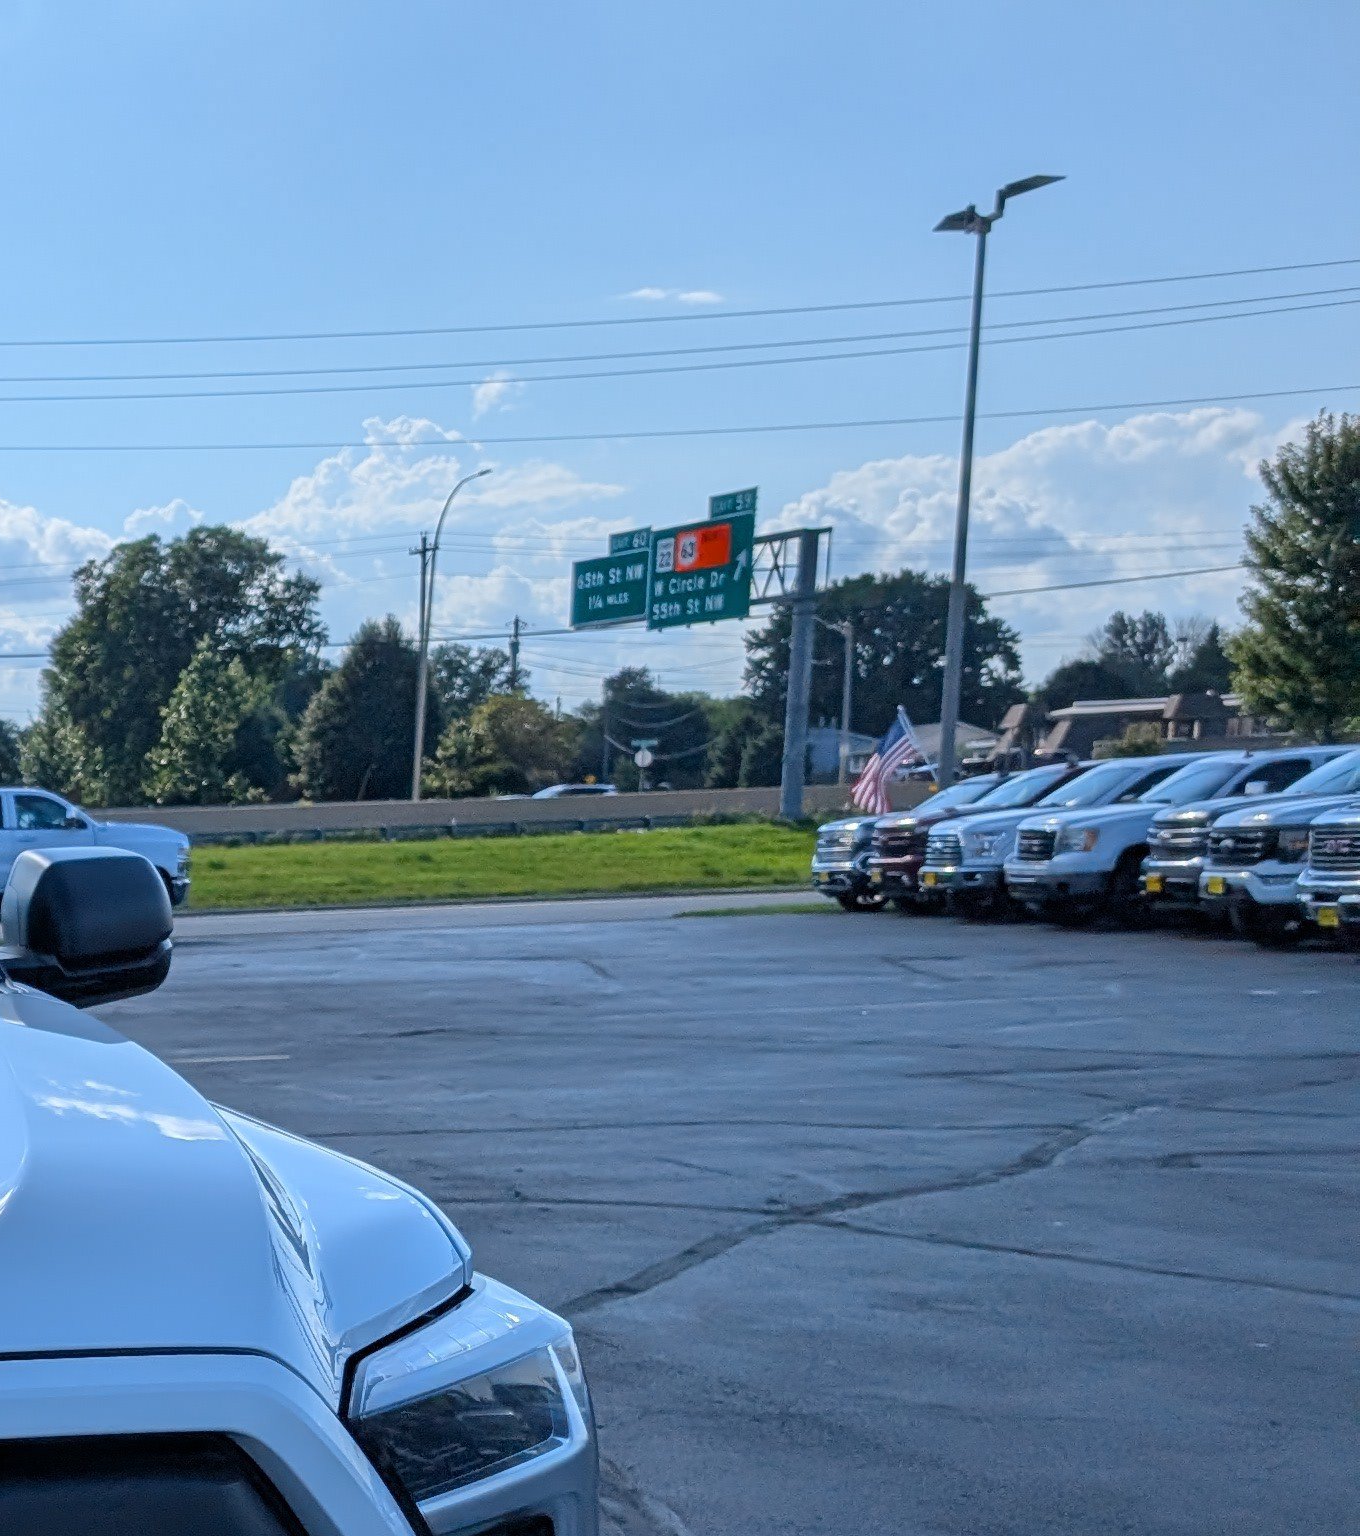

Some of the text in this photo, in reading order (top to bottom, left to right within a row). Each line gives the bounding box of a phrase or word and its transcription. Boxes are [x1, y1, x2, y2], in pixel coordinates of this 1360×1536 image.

[609, 567, 622, 584] St
[625, 563, 644, 581] NW
[668, 575, 705, 594] Circle
[710, 571, 726, 588] Dr
[686, 598, 700, 616] St
[705, 593, 725, 612] NW
